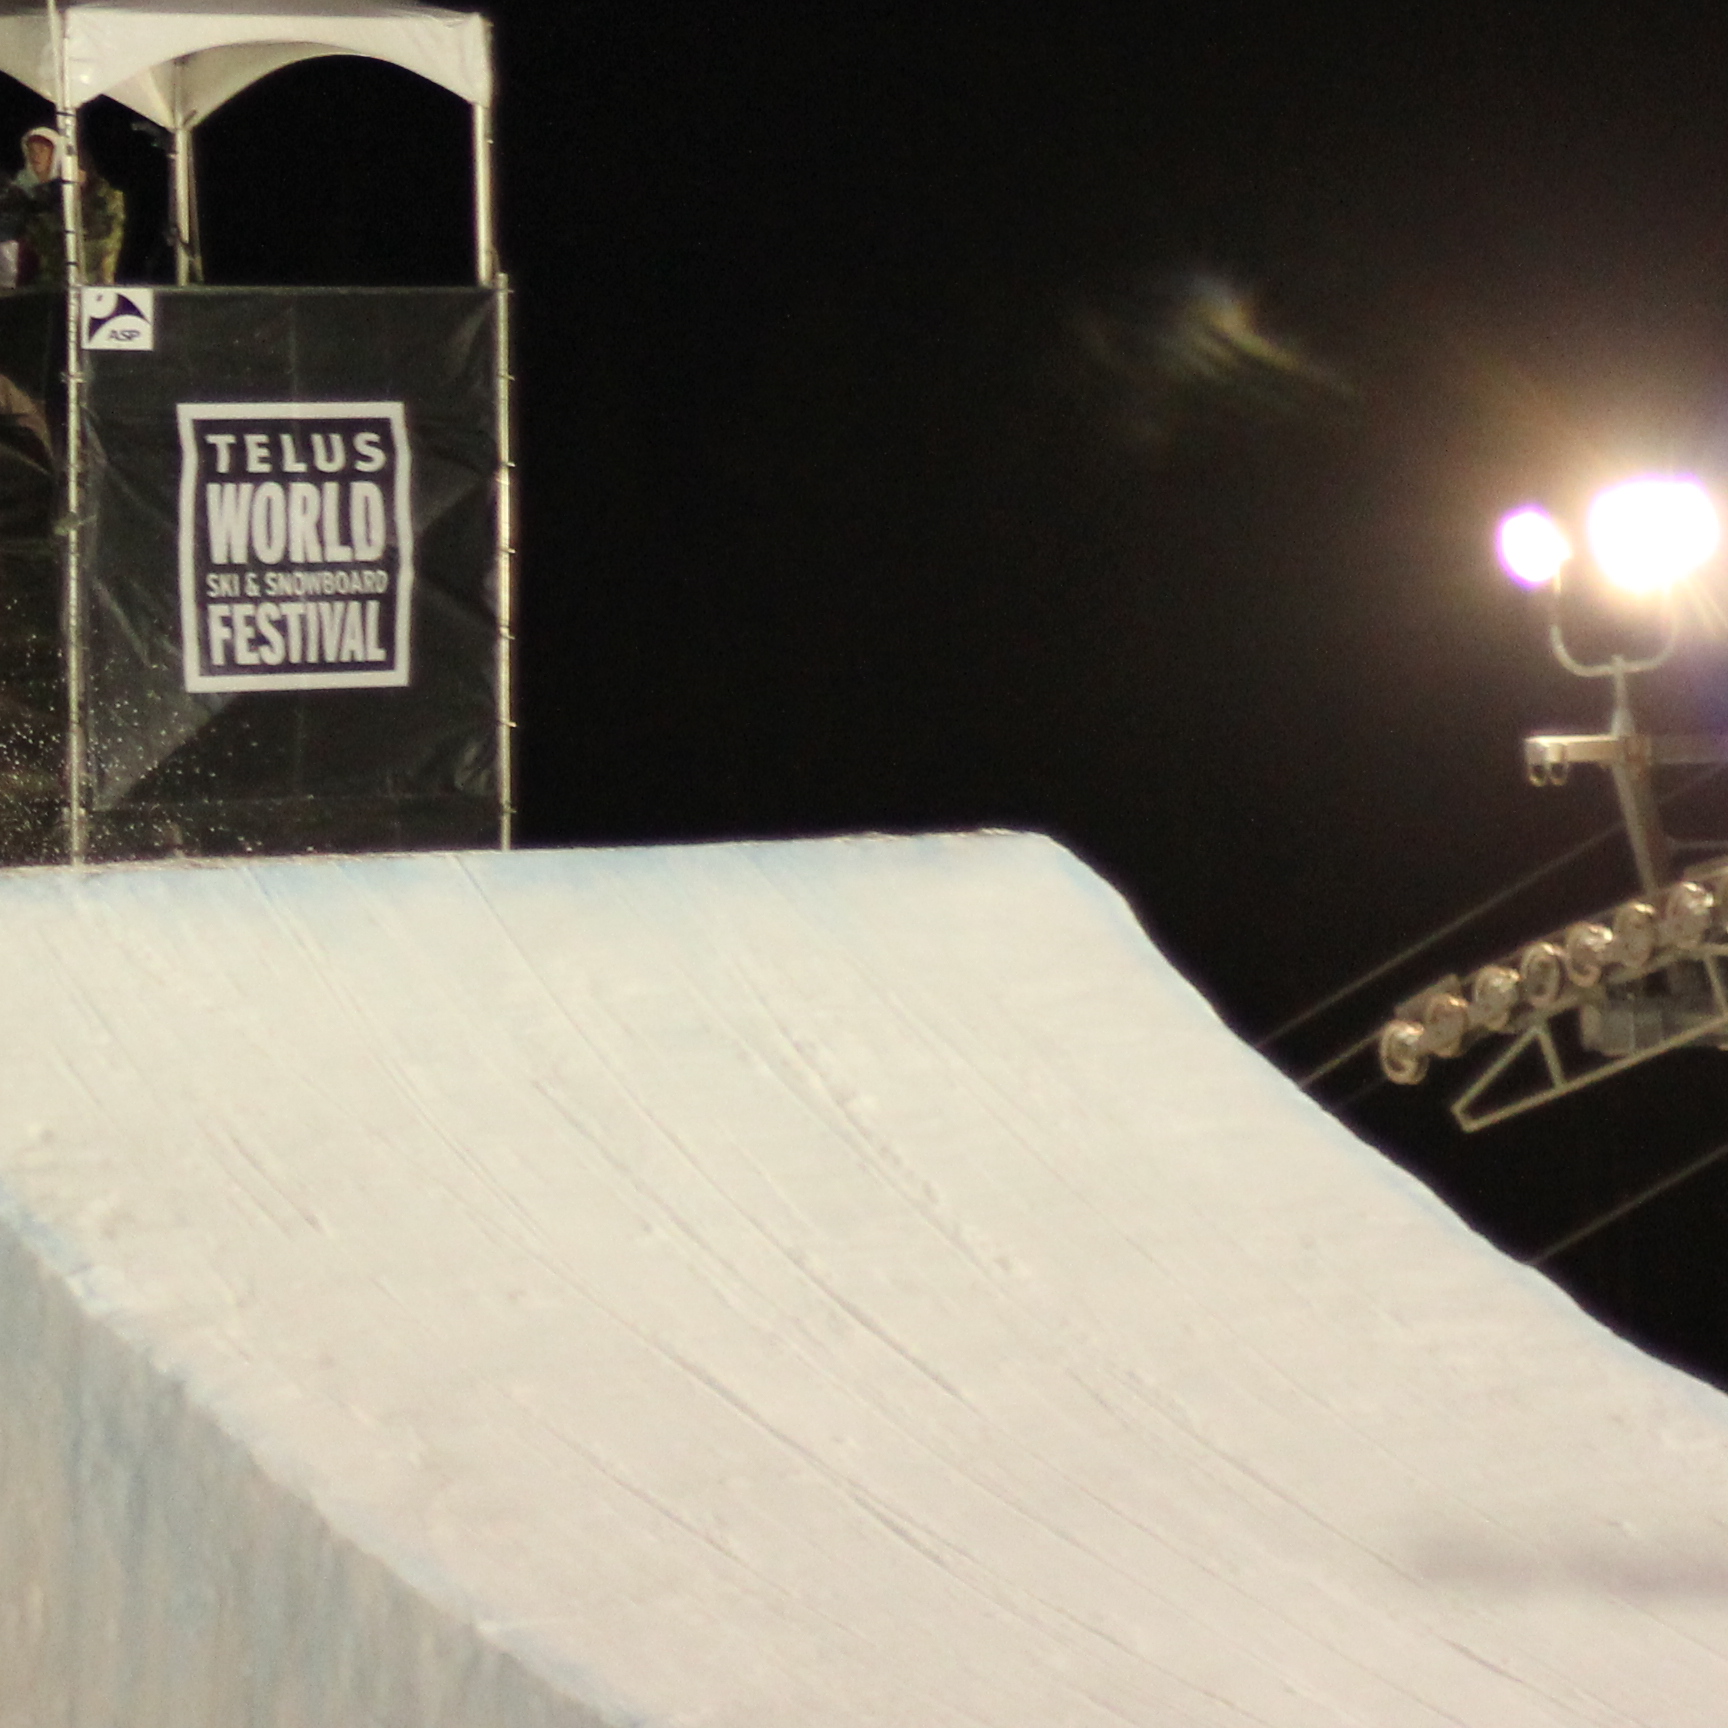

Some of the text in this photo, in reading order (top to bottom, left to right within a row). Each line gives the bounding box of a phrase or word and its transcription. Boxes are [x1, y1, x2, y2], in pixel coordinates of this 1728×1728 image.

[204, 432, 387, 473] TELUS
[206, 480, 387, 565] WORLD
[205, 569, 389, 597] SKI & SNOWBOARD
[207, 600, 387, 665] FESTIVAL
